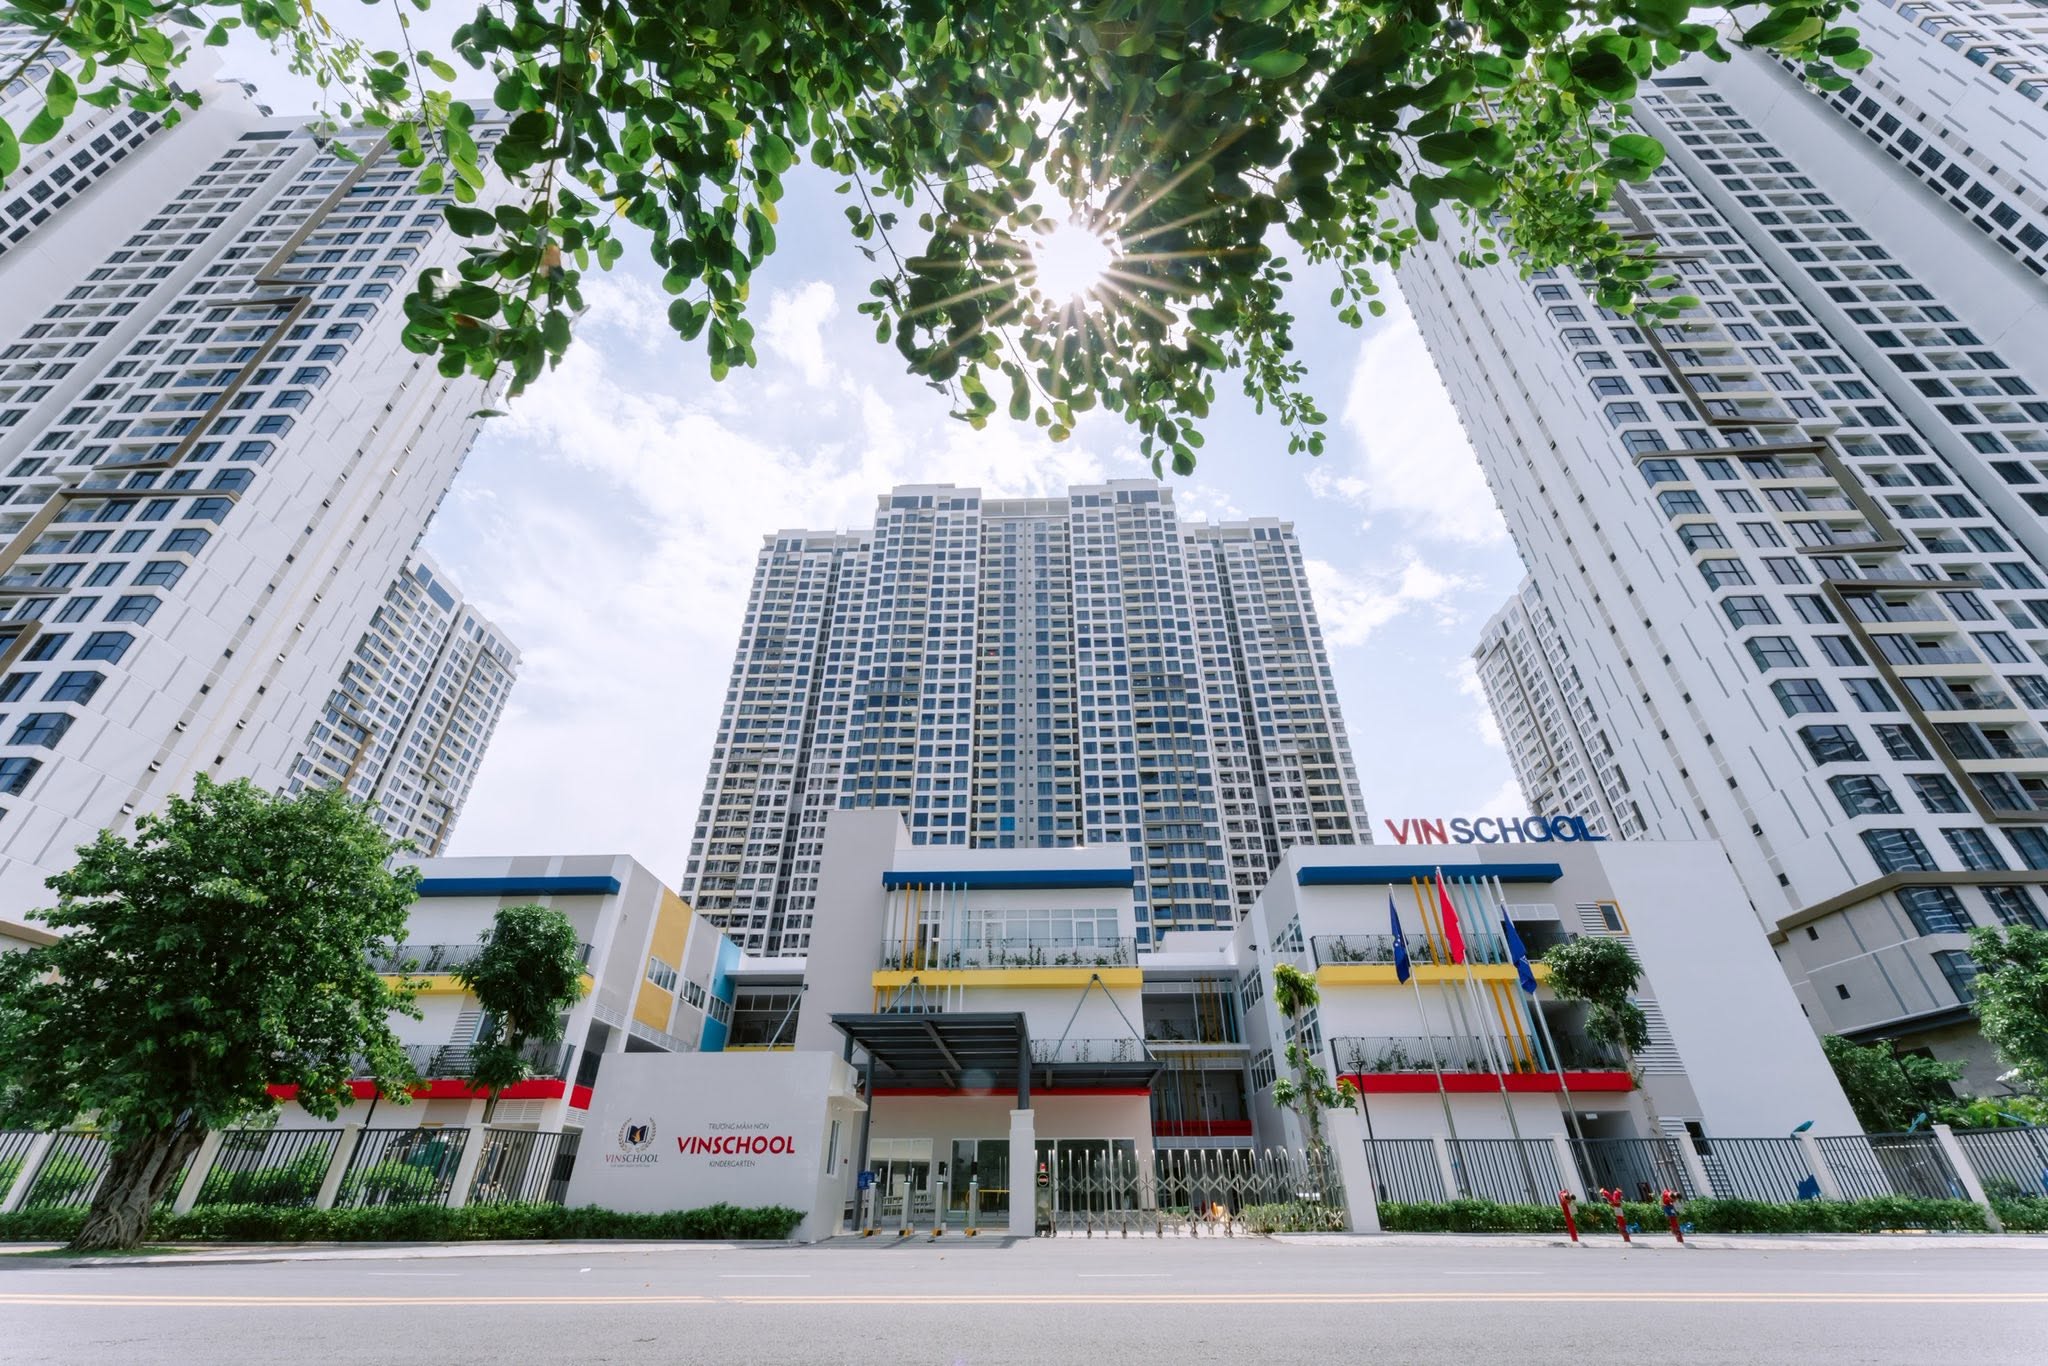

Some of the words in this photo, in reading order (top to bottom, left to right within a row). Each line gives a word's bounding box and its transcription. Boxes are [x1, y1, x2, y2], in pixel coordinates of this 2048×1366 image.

[677, 1136, 795, 1155] VINSCHOOL
[605, 1153, 659, 1163] VINSCHOOL
[709, 1159, 756, 1168] KINDERGARTEN
